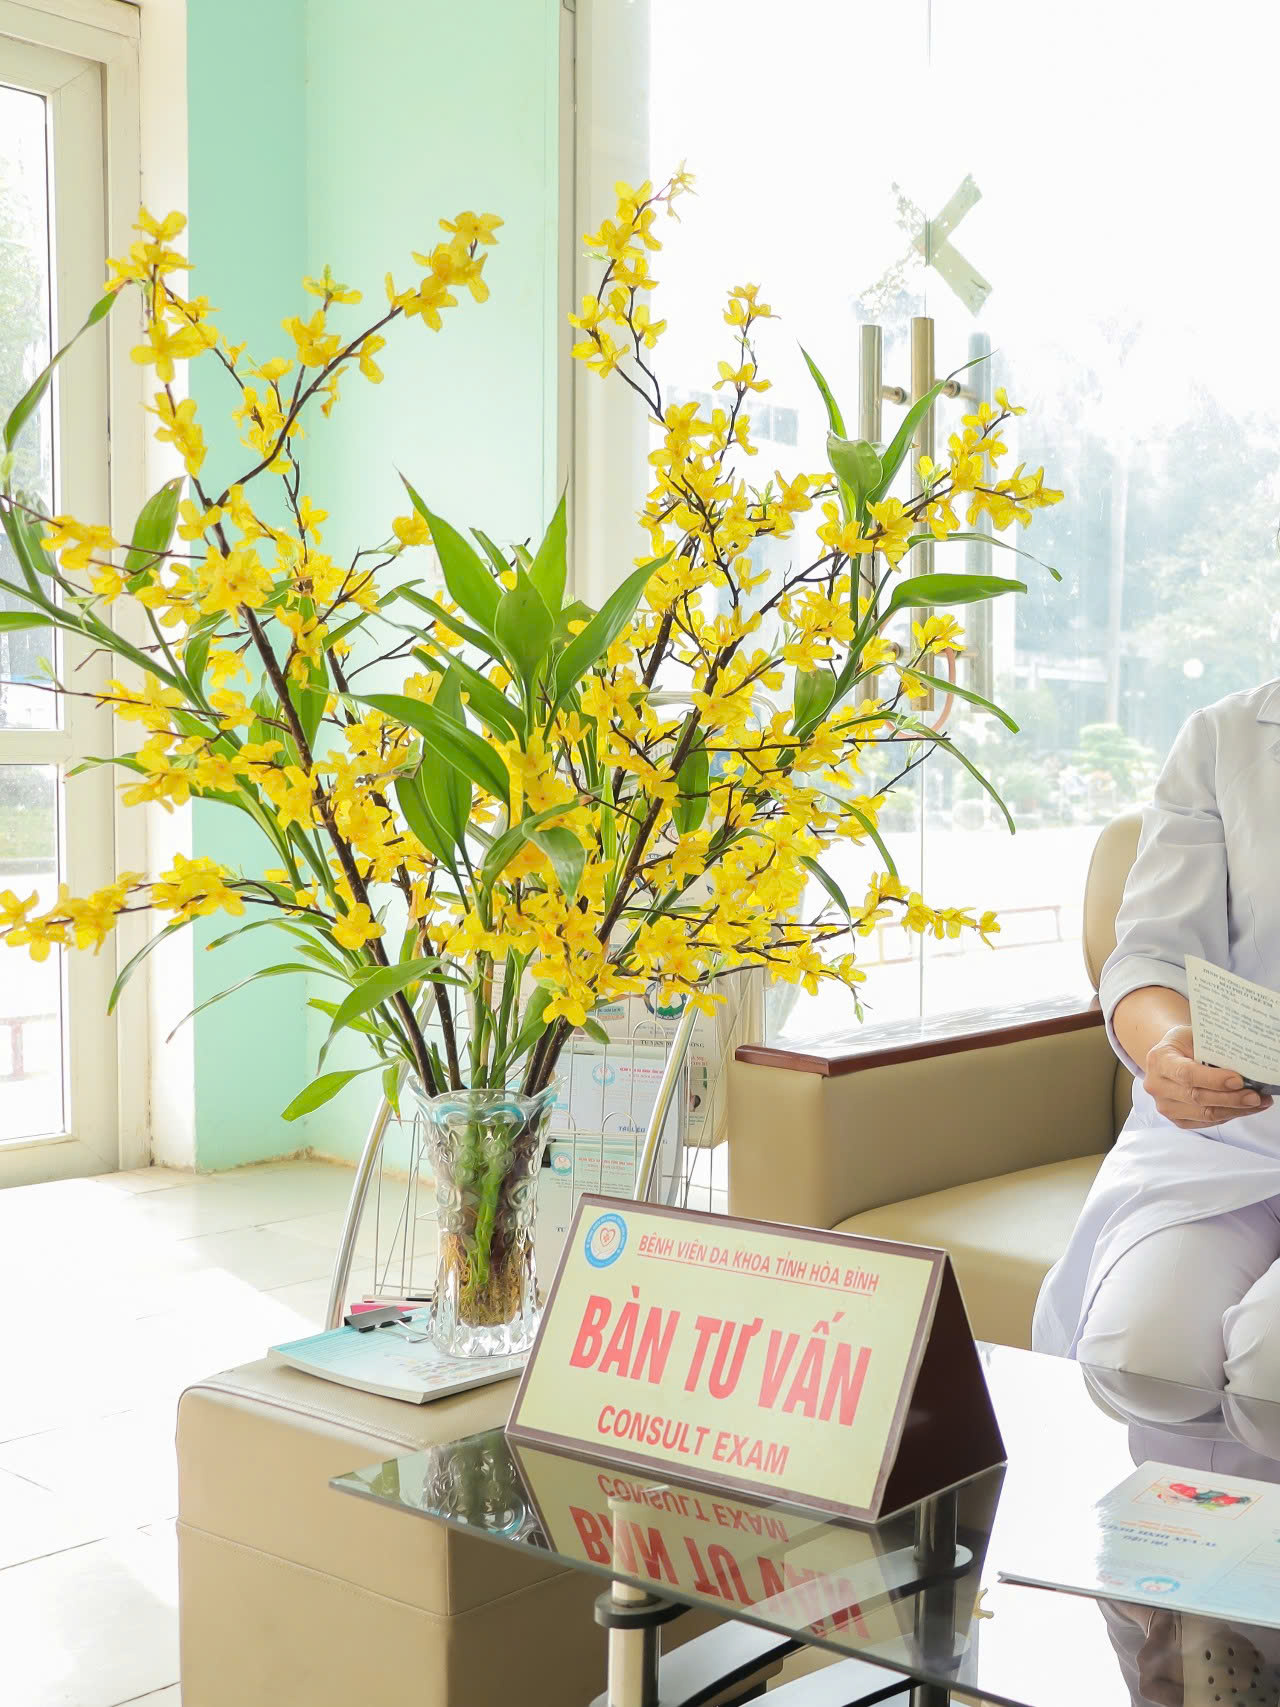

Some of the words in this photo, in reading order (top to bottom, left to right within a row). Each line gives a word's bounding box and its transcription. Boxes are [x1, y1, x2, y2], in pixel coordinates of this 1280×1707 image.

[733, 1250, 770, 1273] KHOA
[809, 1260, 840, 1285] HÒA
[569, 1285, 681, 1384] BÀN
[683, 1315, 764, 1399] TƯ
[758, 1311, 872, 1427] VẤN
[597, 1404, 710, 1456] CONSULT
[712, 1431, 790, 1476] EXAM
